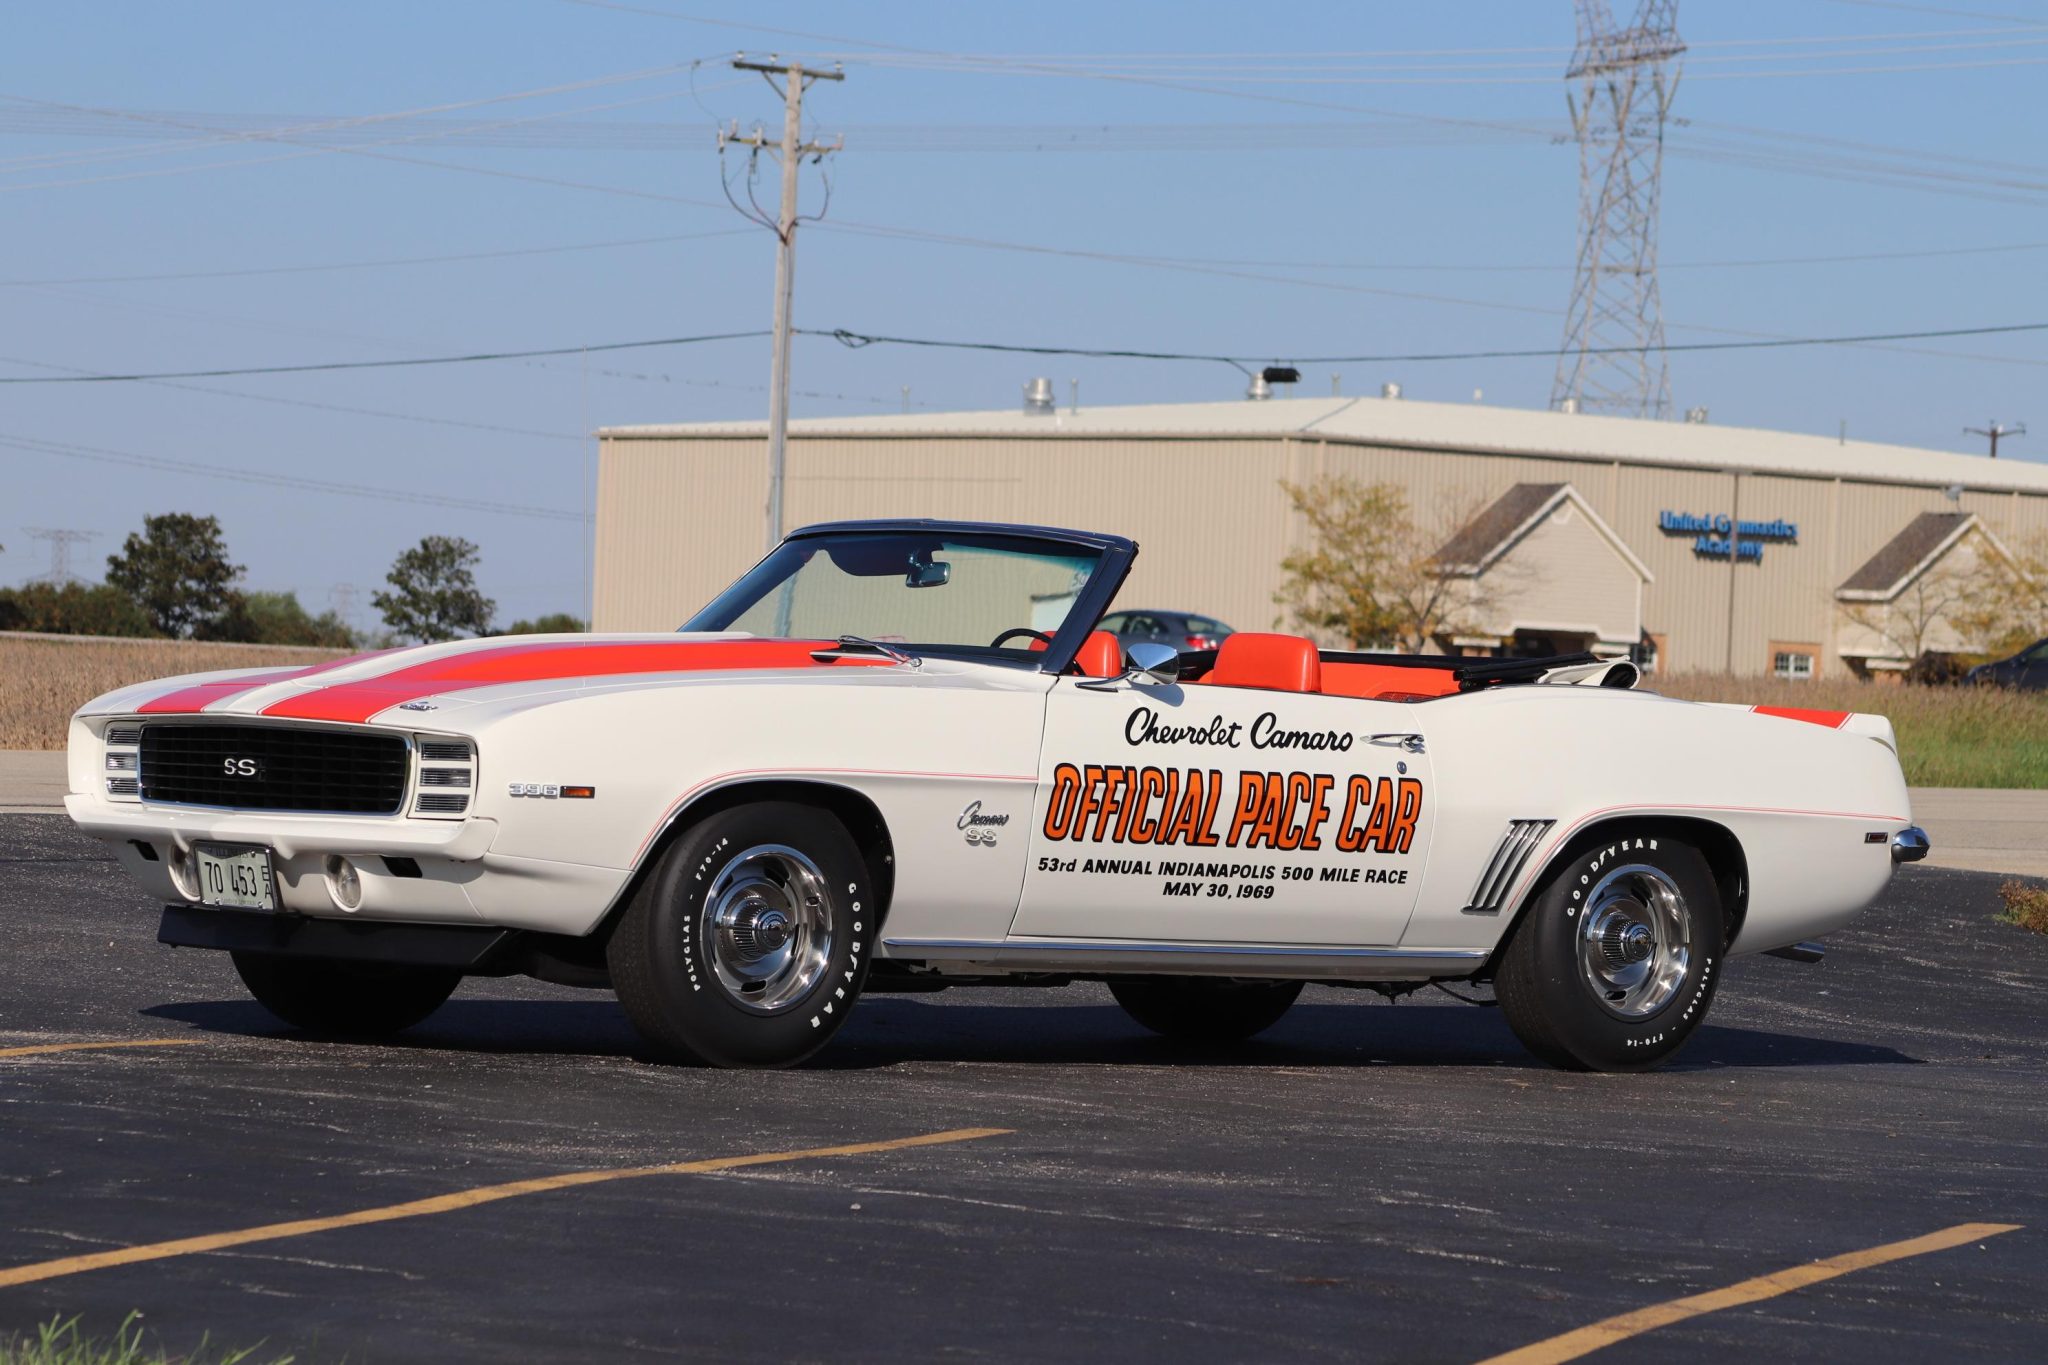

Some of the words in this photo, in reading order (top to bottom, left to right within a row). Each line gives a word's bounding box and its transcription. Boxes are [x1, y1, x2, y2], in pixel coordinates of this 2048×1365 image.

[1660, 511, 1711, 531] United
[1125, 707, 1242, 748] Chevrolet
[1250, 712, 1353, 752] Camaro
[224, 758, 256, 776] SS
[509, 783, 558, 797] 396
[1043, 763, 1222, 847] OFFICIAL
[1226, 771, 1335, 851] PACE
[1335, 774, 1423, 854] CAR
[965, 828, 997, 844] SS
[204, 861, 224, 894] 70
[230, 864, 258, 897] 453
[1038, 857, 1077, 873] 53rd
[1082, 858, 1153, 876] ANNUAL
[1158, 861, 1276, 880] INDIANAPOLIS
[1281, 866, 1313, 881] 500
[1319, 867, 1361, 883] MILE
[1365, 869, 1409, 885] RACE
[1566, 838, 1658, 917] GOODYEAR
[1163, 882, 1203, 897] MAY
[683, 915, 701, 992] POLYGLAS
[810, 882, 862, 1028] GOODYEAR
